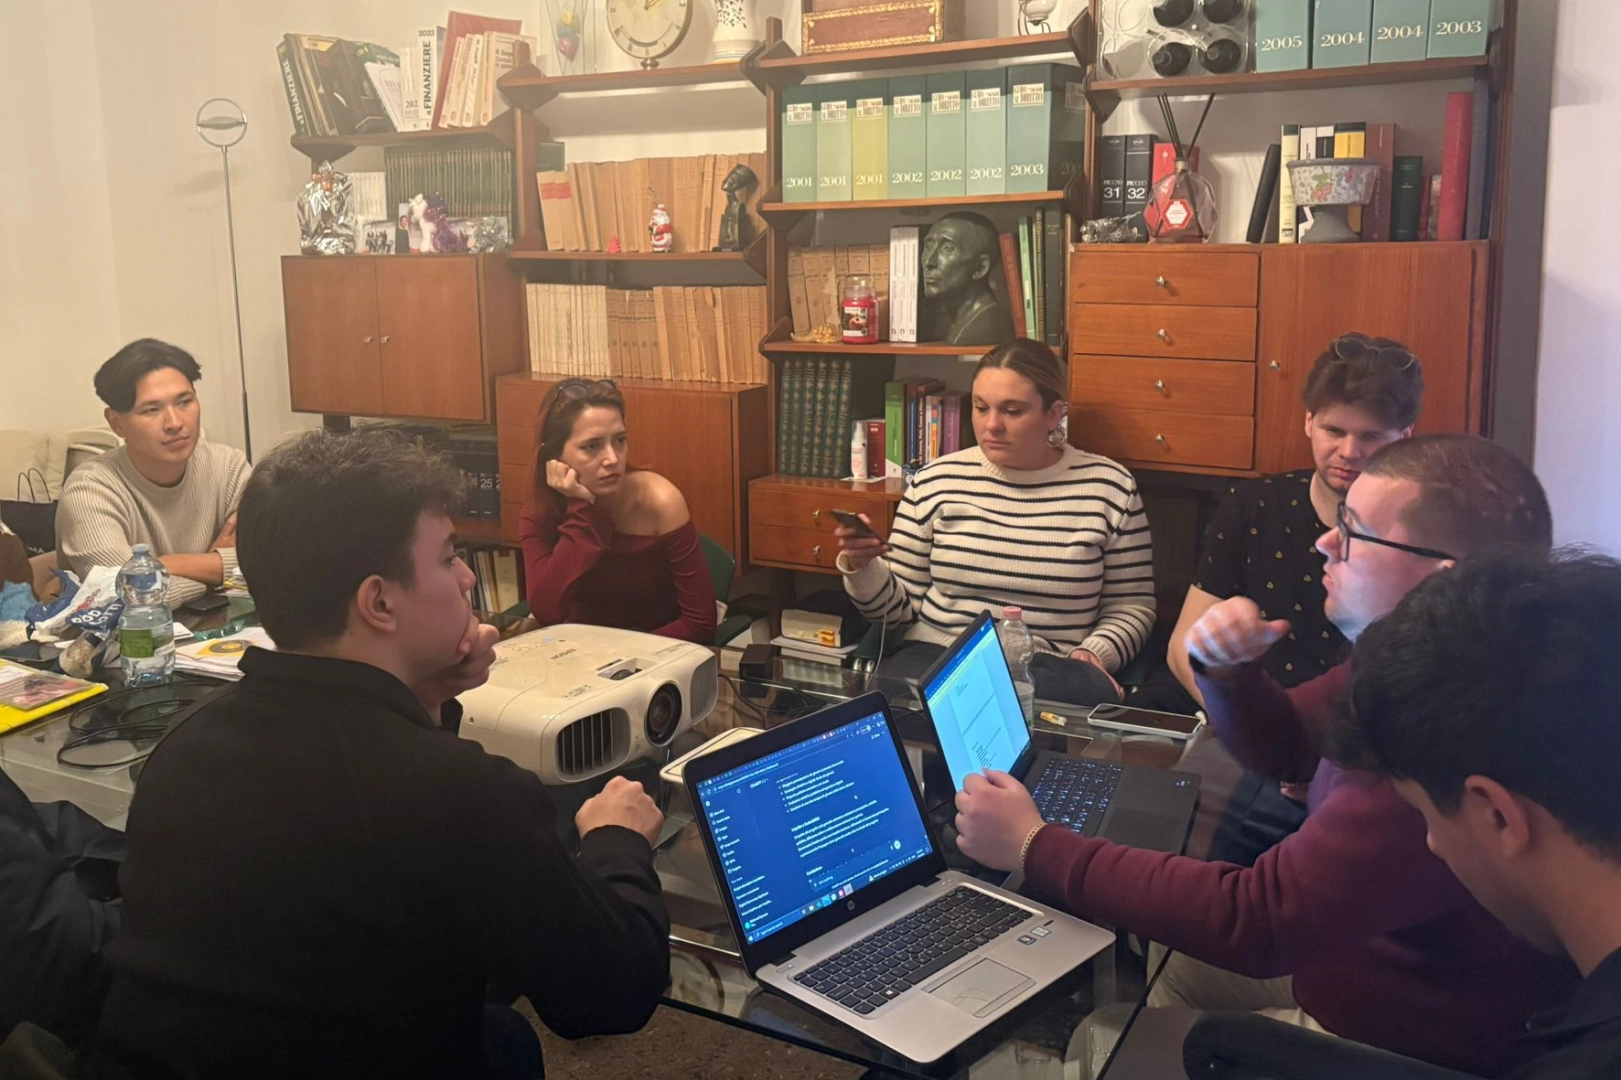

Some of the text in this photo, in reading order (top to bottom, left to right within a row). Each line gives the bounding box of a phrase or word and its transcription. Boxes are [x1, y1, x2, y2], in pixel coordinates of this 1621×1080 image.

[1377, 24, 1424, 40] 2004
[1435, 20, 1482, 35] 2003
[1261, 35, 1303, 51] 2005
[1320, 31, 1365, 47] 2004
[423, 40, 432, 110] FINANZIERE
[930, 169, 962, 181] 2002
[970, 167, 1002, 180] 2002
[1010, 163, 1044, 176] 2003
[785, 176, 813, 188] 2001
[820, 175, 847, 187] 2001
[856, 173, 883, 186] 2001
[892, 171, 923, 184] 2002
[1103, 187, 1120, 199] 31
[1127, 187, 1146, 199] 32
[480, 478, 493, 489] 25
